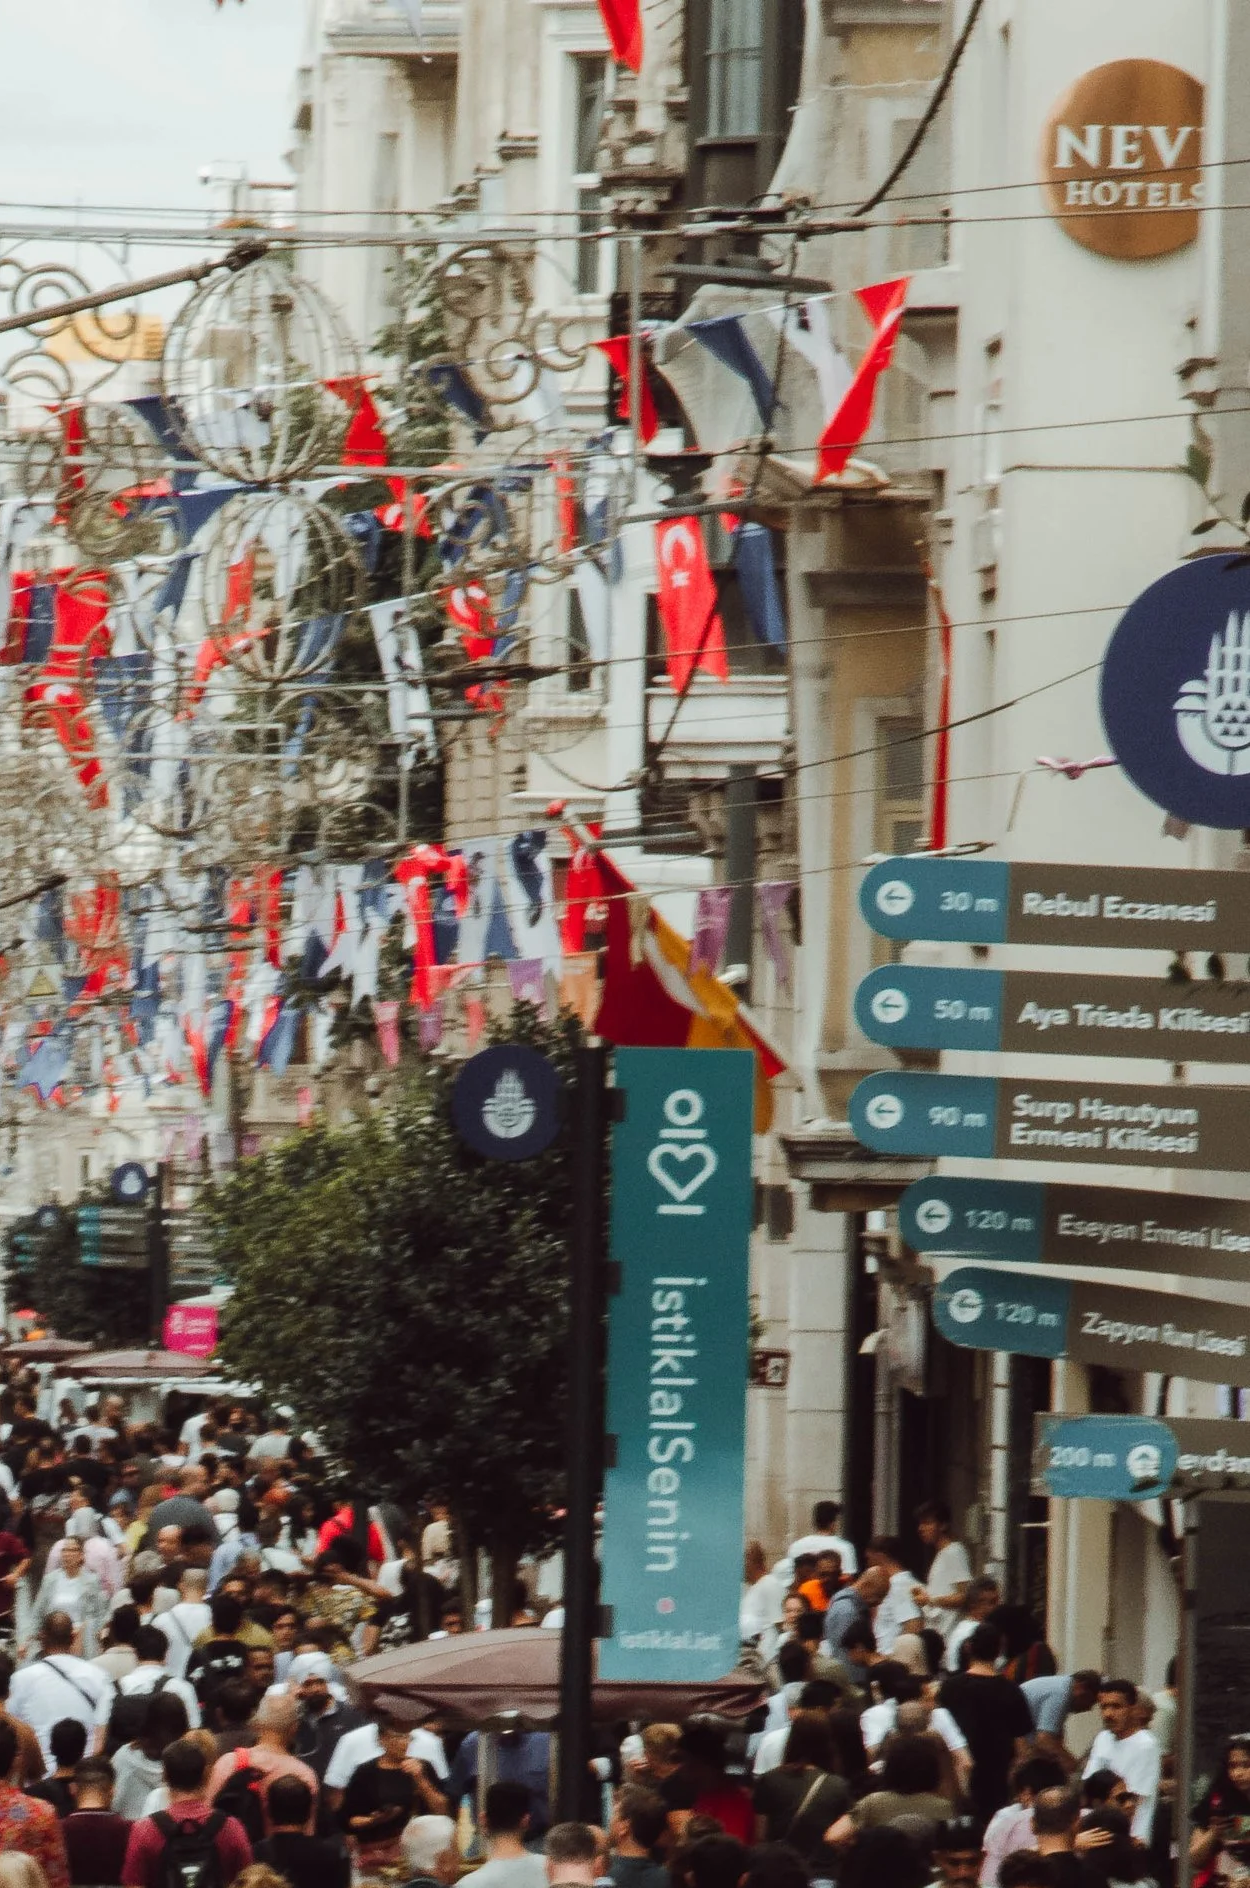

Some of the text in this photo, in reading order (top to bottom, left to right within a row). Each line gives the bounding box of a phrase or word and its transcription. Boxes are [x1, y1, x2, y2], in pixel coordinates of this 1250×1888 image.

[1053, 124, 1204, 169] NEV
[940, 891, 1216, 922] 30 m Rebul Eczanesi
[934, 999, 1250, 1033] 50 m Aya Triada Kilisesi
[929, 1106, 987, 1128] 90 m
[1012, 1094, 1198, 1129] Surp Harutyun
[1010, 1122, 1198, 1153] Ermeni Kilisesi
[965, 1210, 1008, 1230] 120
[1011, 1218, 1034, 1231] m
[1140, 1221, 1209, 1249] Ermeni
[995, 1302, 1036, 1324] 120
[1037, 1313, 1060, 1327] m
[1081, 1312, 1159, 1345] Zapyon
[1093, 1453, 1116, 1467] m
